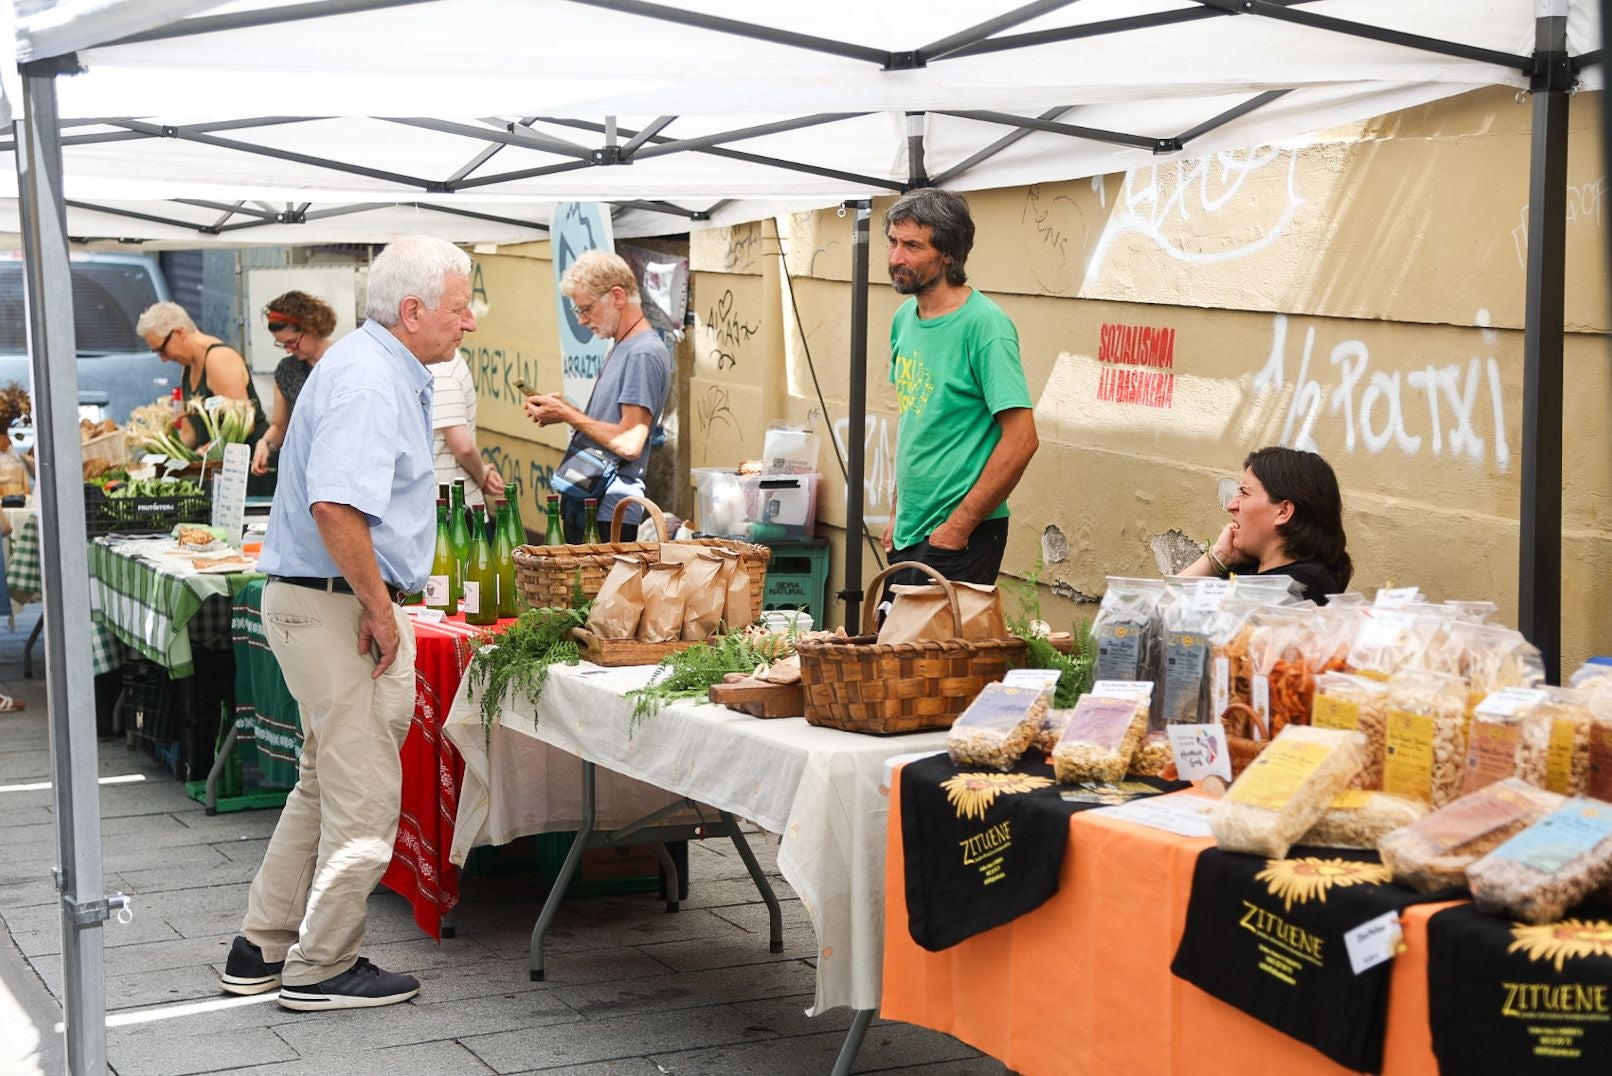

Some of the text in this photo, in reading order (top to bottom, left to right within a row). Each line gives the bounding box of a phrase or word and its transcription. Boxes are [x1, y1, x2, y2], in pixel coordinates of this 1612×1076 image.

[1098, 323, 1176, 369] SOZIALISMOA
[769, 587, 805, 595] NATURAL
[959, 820, 1011, 865] ZITUENE
[1239, 900, 1325, 959] ZITUENE
[1502, 982, 1610, 1017] ZITUENE
